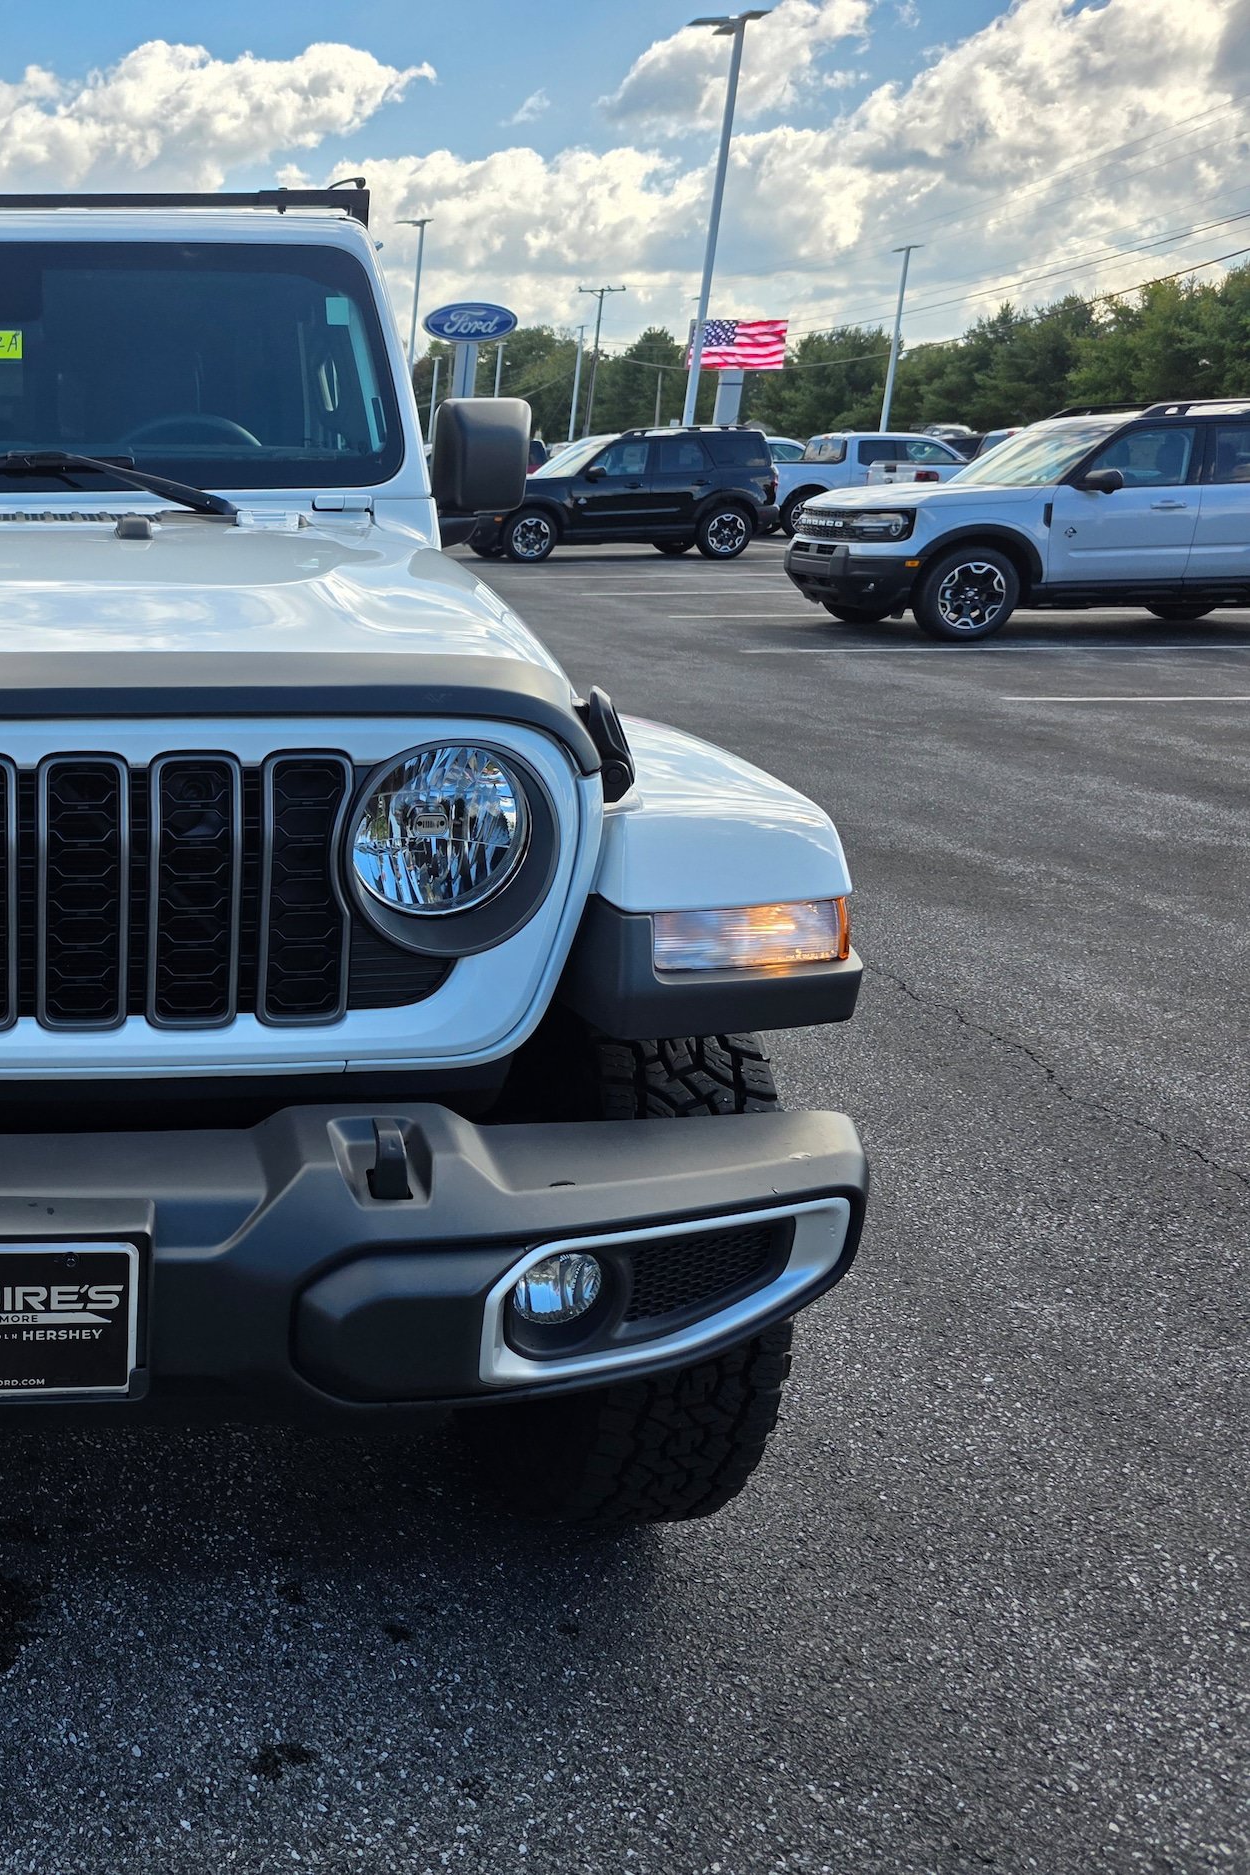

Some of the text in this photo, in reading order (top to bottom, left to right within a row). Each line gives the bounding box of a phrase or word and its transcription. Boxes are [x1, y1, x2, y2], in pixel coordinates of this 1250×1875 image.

[443, 310, 499, 334] Ford
[0, 1314, 39, 1323] MORE
[22, 1328, 103, 1341] HERSHEY
